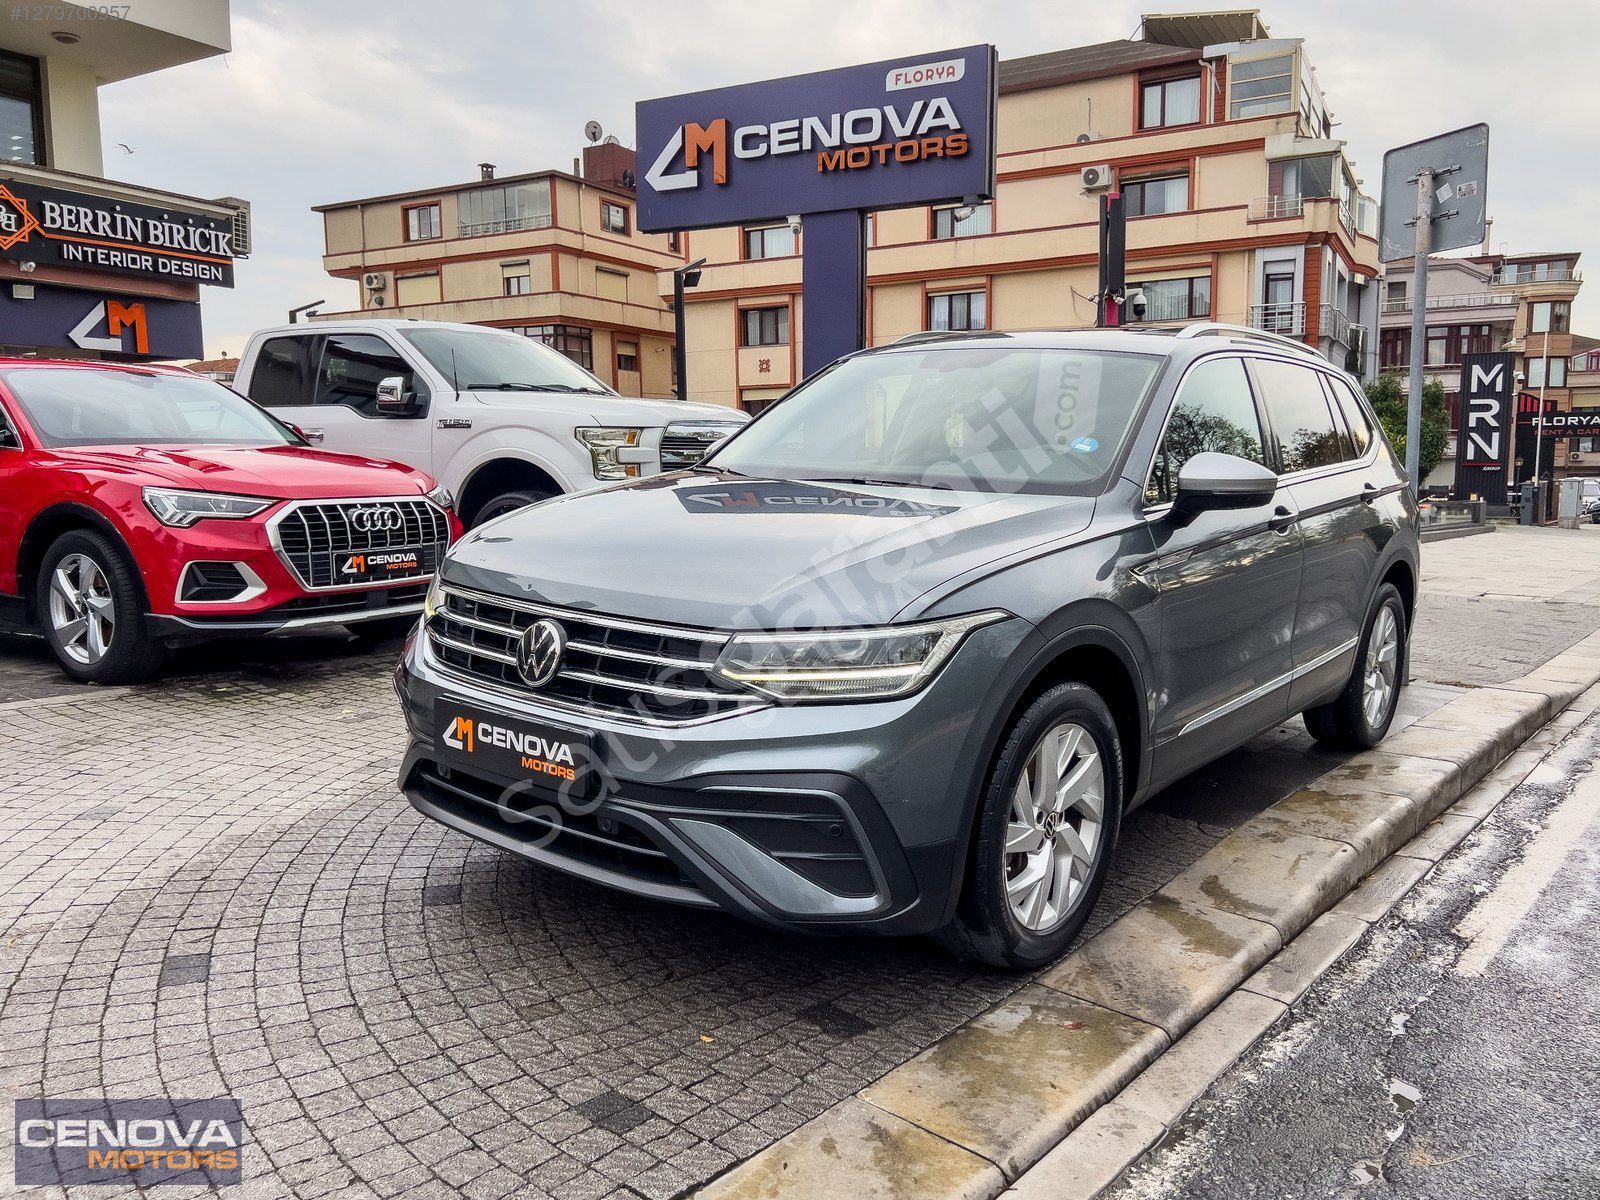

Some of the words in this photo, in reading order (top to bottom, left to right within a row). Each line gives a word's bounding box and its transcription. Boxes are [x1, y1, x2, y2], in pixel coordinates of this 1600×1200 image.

[894, 65, 956, 85] FLORYA
[733, 97, 962, 159] CENOVA
[816, 133, 969, 173] MOTORS
[62, 243, 153, 272] INTERIOR
[158, 258, 223, 282] DESIGN
[1466, 364, 1504, 461] MRN
[367, 553, 417, 565] CENOVA
[386, 561, 418, 570] MOTORS
[477, 722, 575, 766] CENOVA
[521, 756, 576, 781] MOTORS
